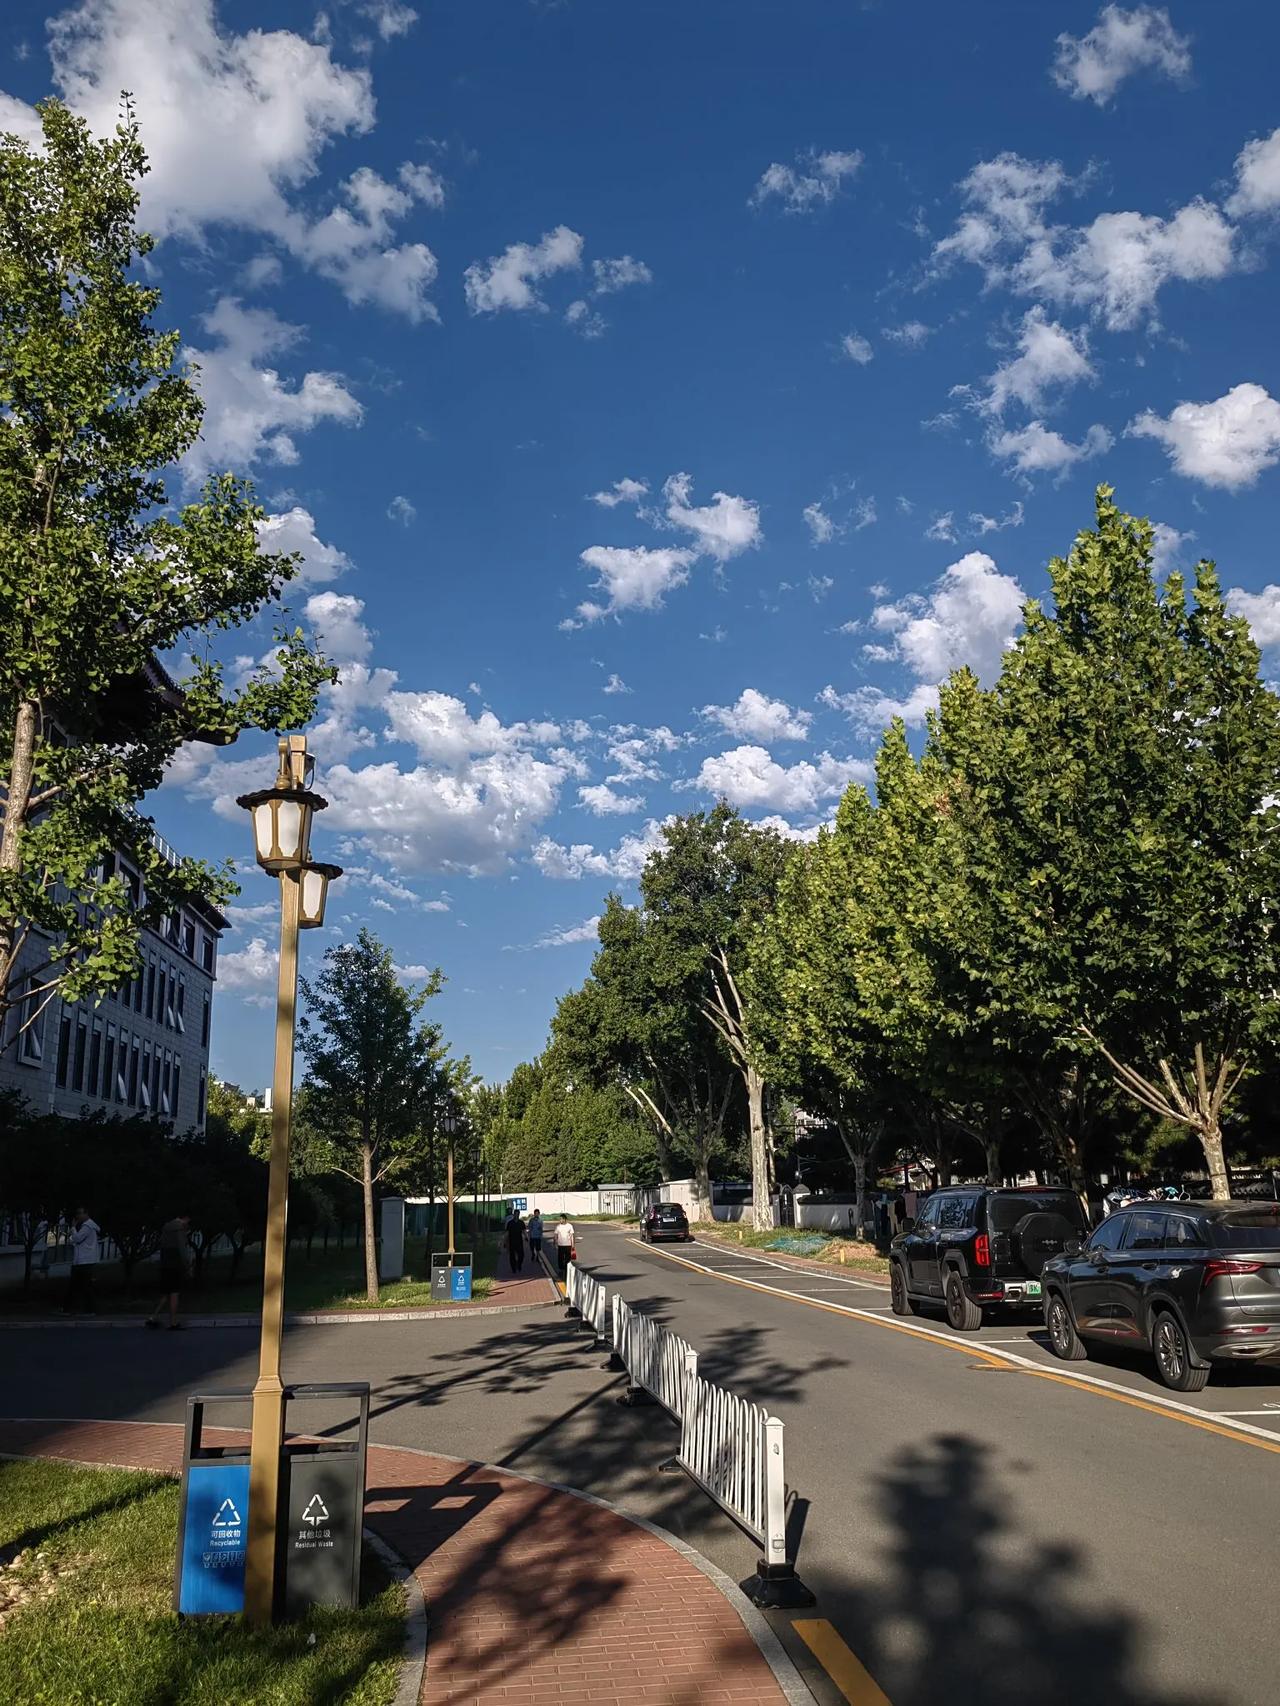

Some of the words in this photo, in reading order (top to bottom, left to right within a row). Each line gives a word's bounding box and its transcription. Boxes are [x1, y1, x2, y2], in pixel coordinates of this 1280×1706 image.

[211, 1529, 241, 1539] 可回收物
[299, 1529, 331, 1540] 其他垃圾
[209, 1539, 241, 1547] Recyclable
